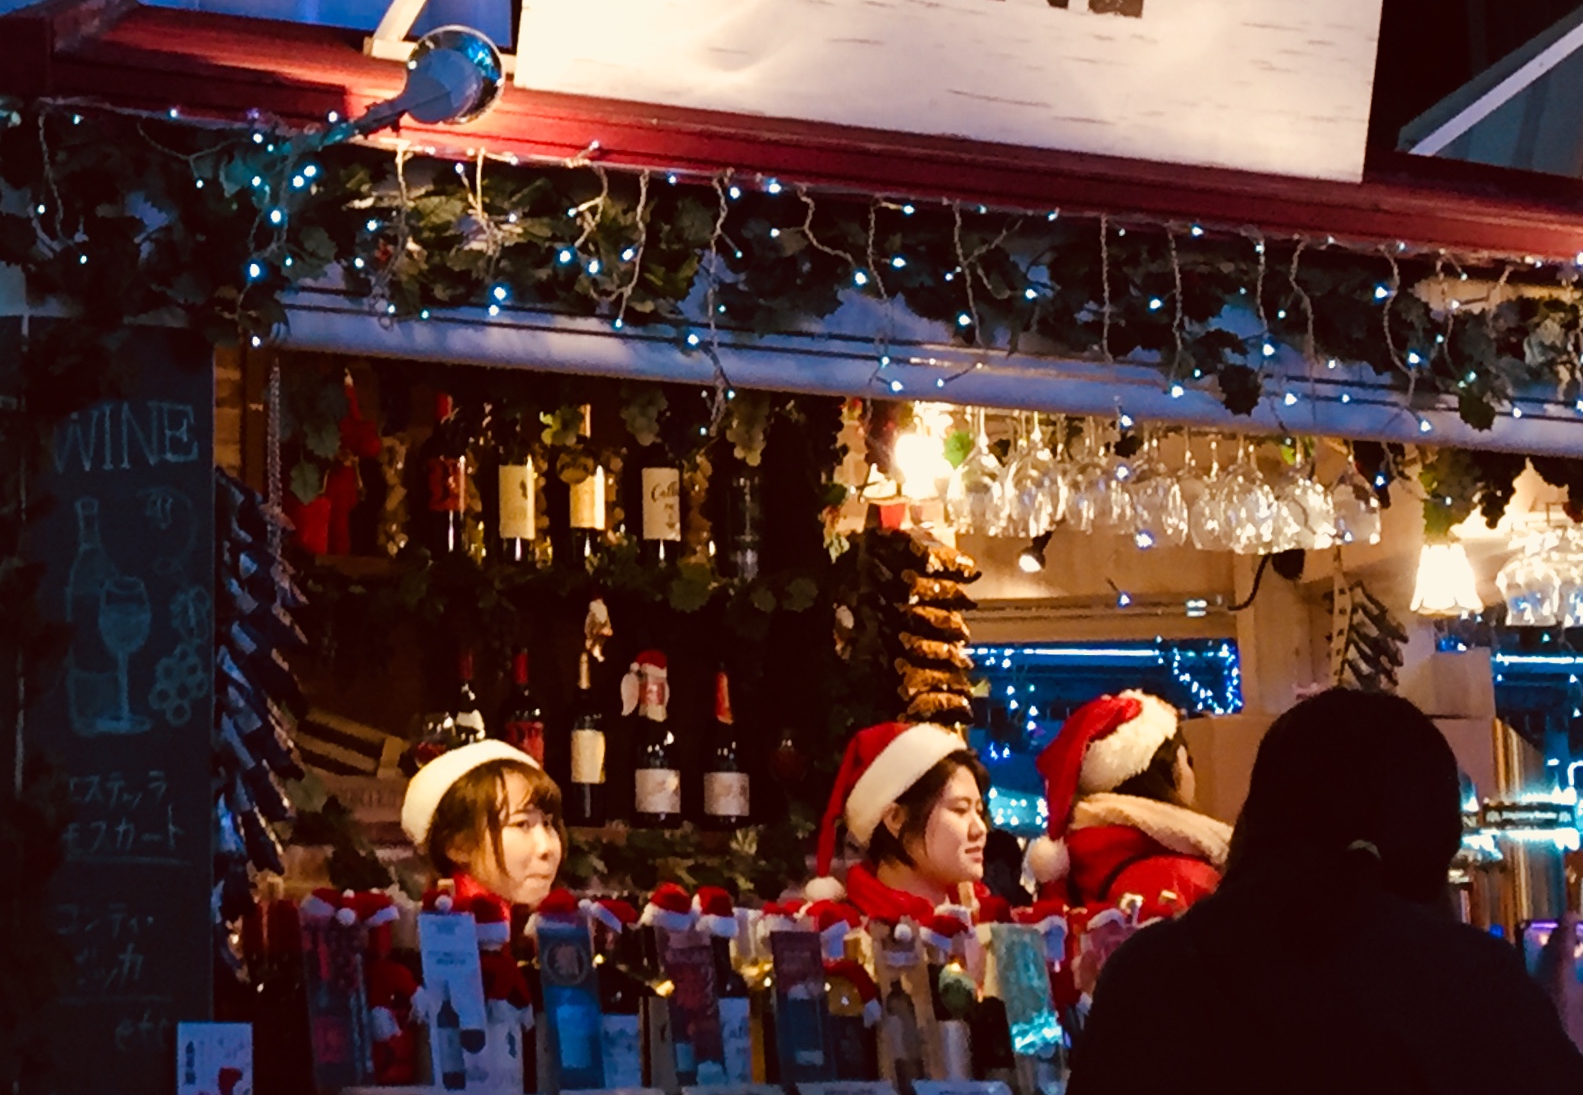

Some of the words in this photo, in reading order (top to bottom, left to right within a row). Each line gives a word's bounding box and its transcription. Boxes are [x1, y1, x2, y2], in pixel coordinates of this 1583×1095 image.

[53, 399, 199, 473] WINE
[60, 803, 186, 855] モスカート
